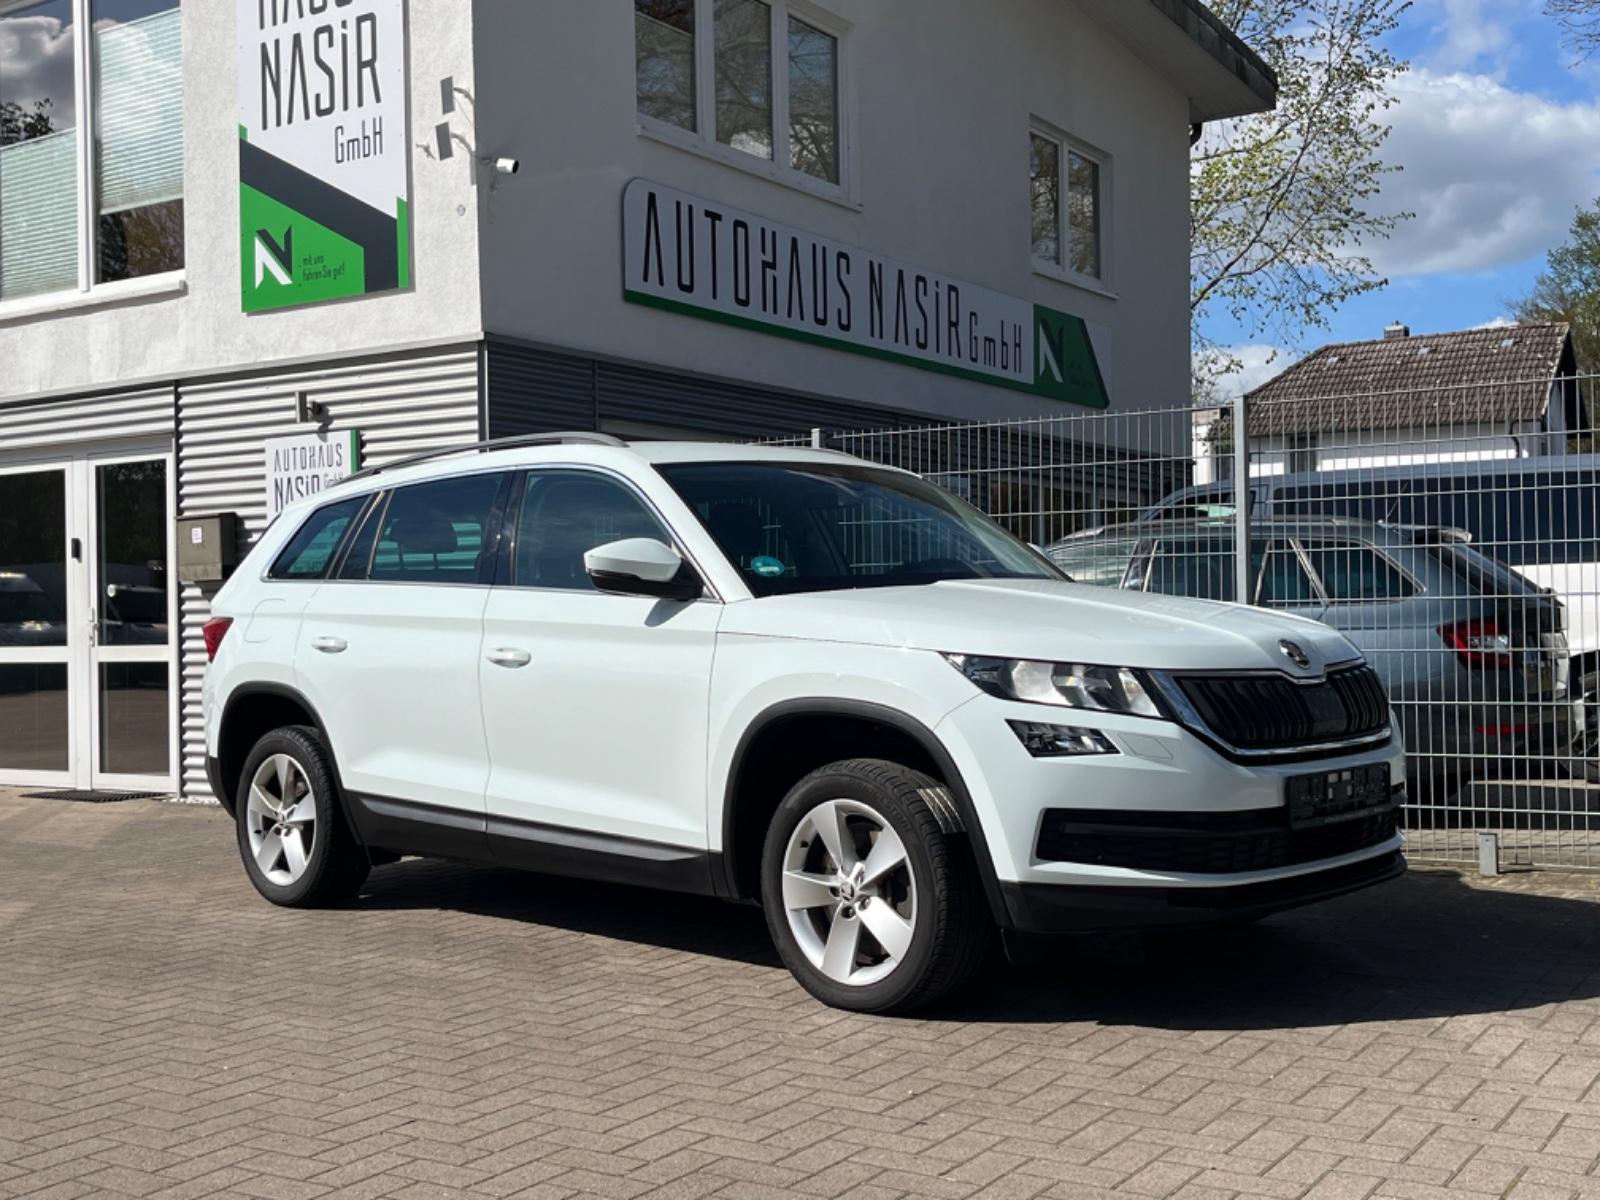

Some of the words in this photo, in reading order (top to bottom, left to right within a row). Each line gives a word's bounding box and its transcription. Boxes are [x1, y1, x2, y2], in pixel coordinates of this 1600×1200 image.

[334, 116, 383, 164] GmbH
[643, 191, 850, 332] AUTOHAUS
[969, 311, 1022, 374] GmbH
[274, 443, 343, 472] AUTOHAUS
